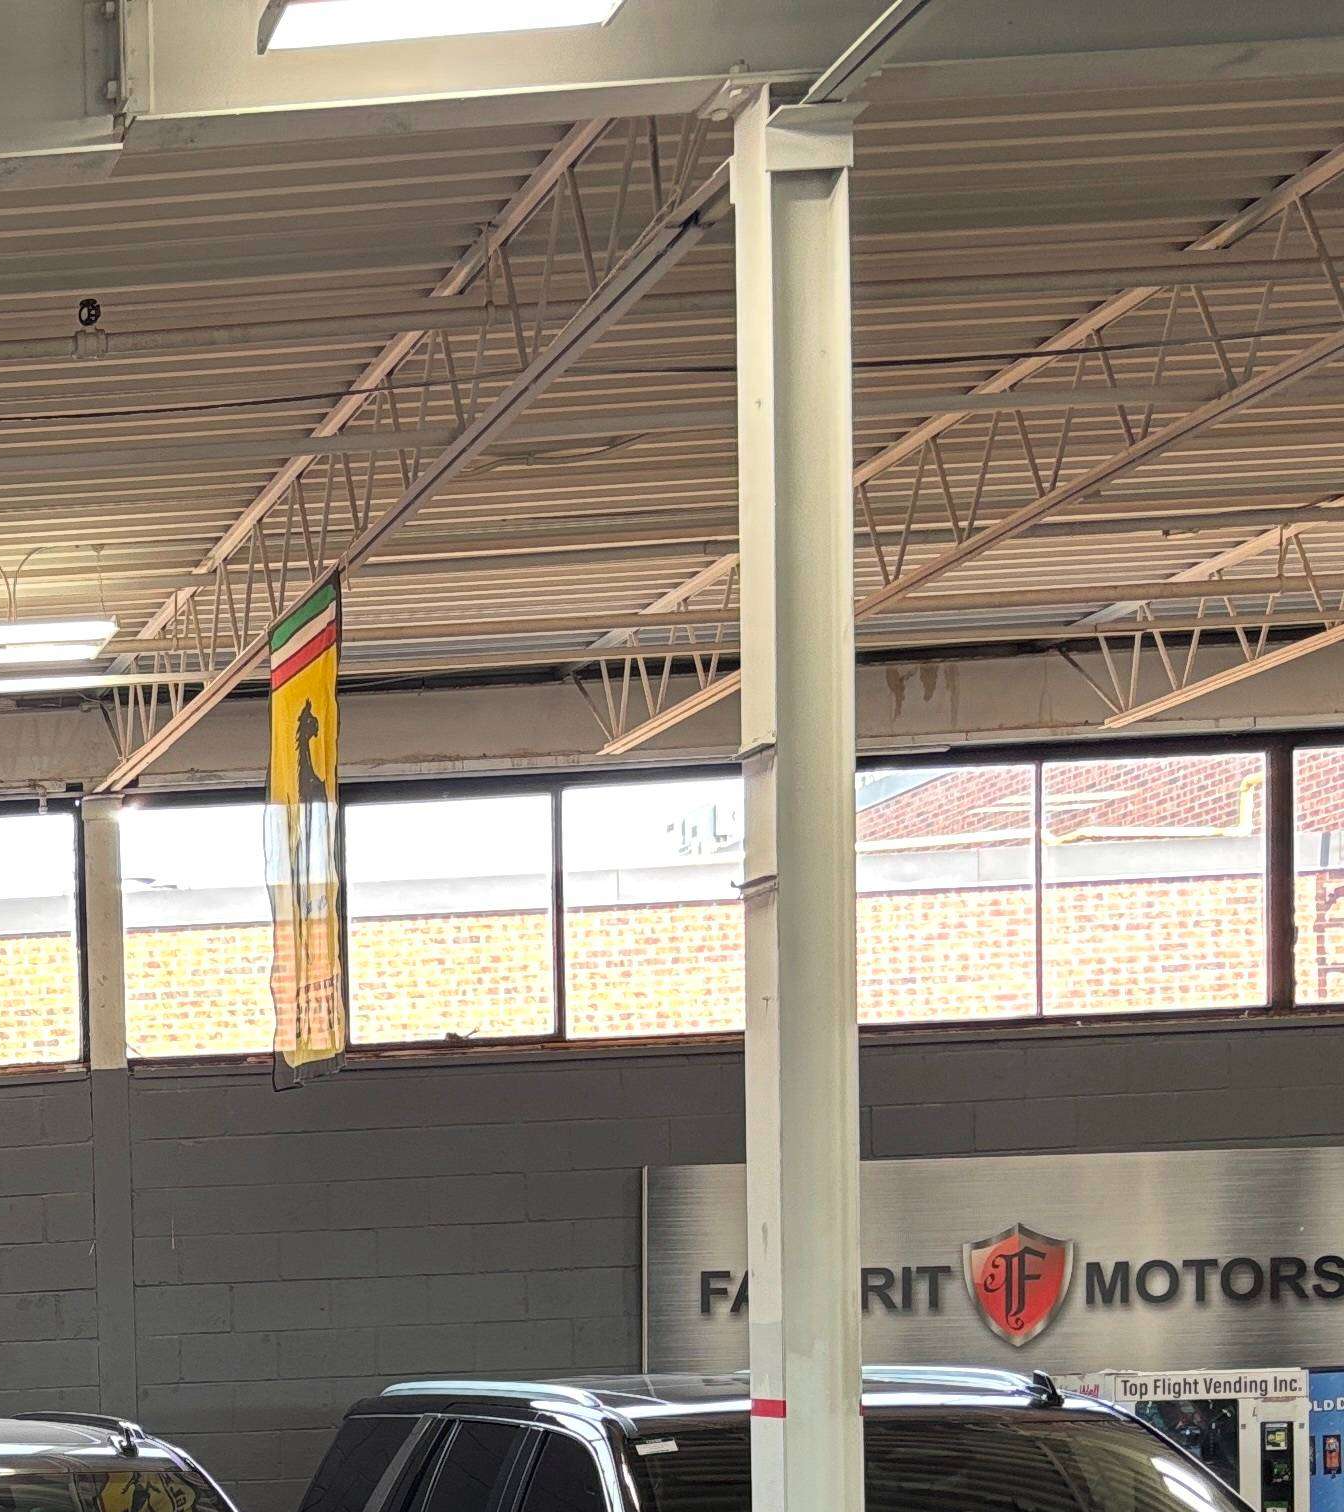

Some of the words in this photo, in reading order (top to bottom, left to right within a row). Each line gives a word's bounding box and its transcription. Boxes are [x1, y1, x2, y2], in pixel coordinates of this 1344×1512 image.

[1085, 1255, 1344, 1304] MOTORS
[1121, 1379, 1148, 1399] Top
[1153, 1378, 1199, 1398] Flight
[1203, 1376, 1268, 1396] Vending
[1273, 1375, 1302, 1392] Inc.
